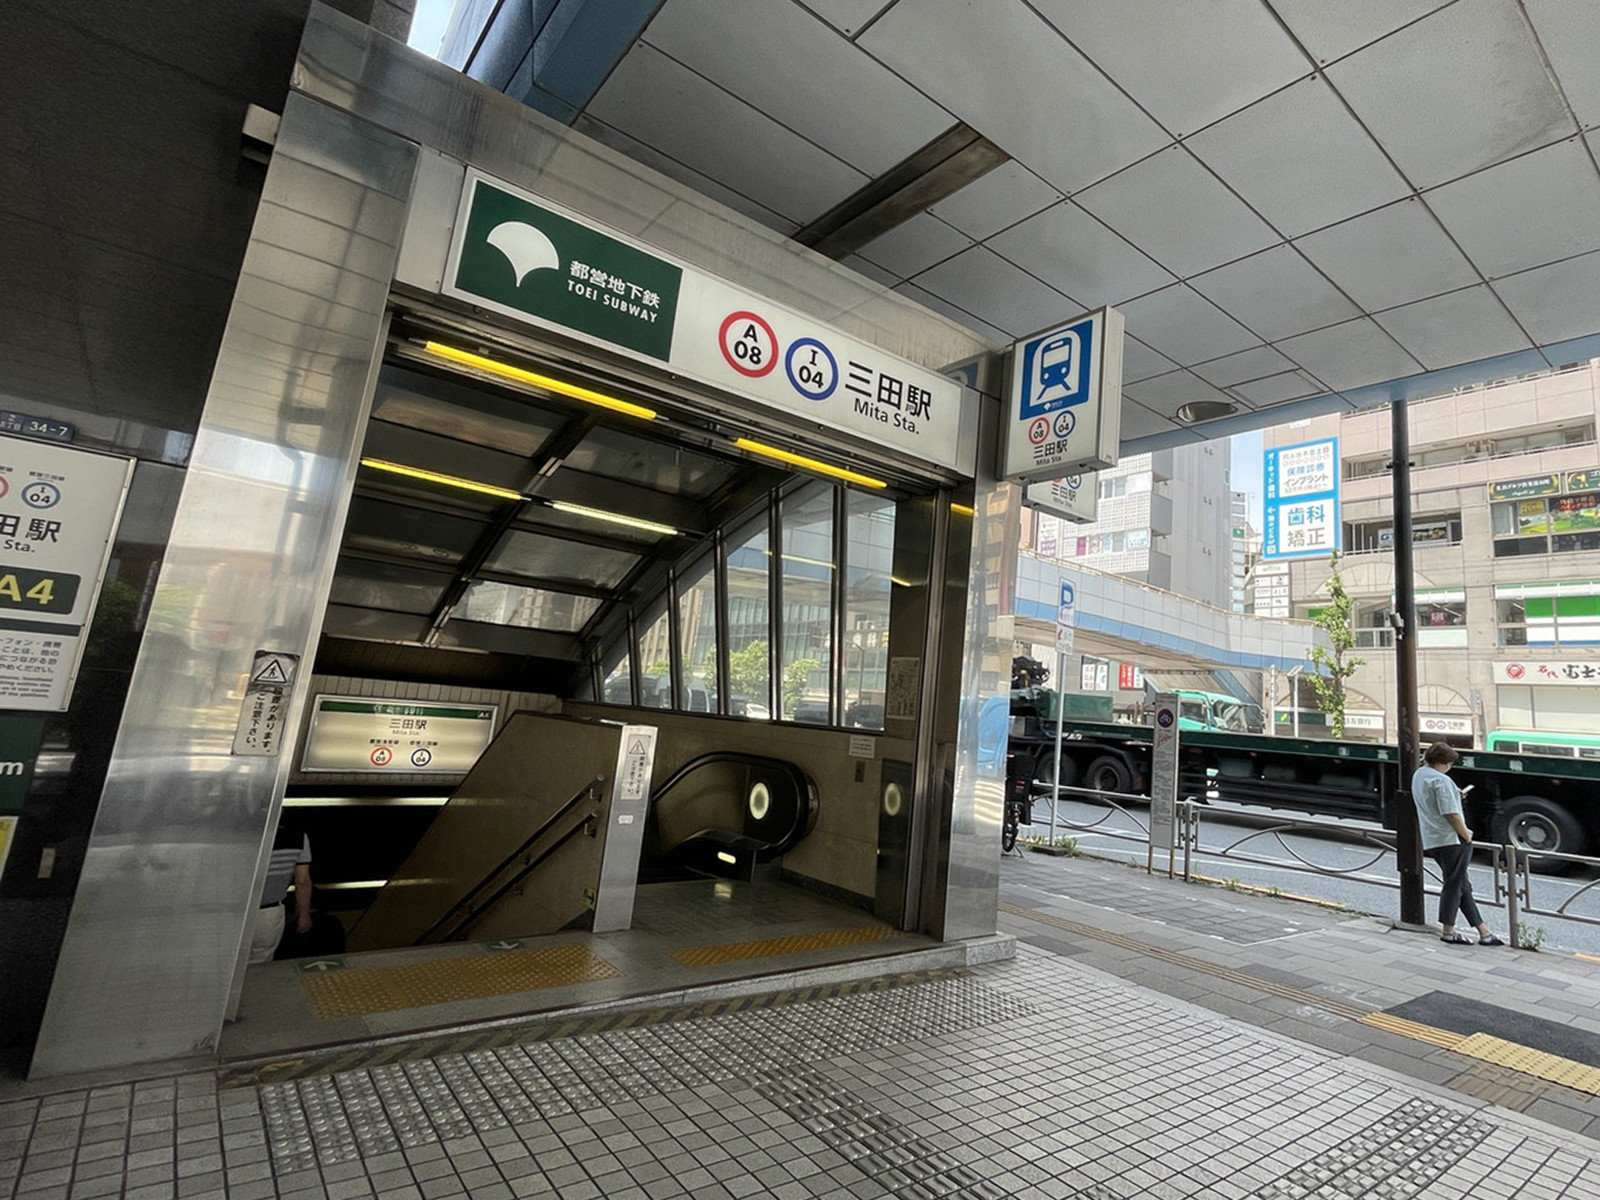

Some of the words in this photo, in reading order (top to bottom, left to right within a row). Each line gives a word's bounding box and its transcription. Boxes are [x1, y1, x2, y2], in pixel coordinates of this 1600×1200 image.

[570, 260, 660, 309] 都営地下鉄
[567, 280, 597, 300] TOEI
[603, 294, 657, 323] SUBWAY
[743, 323, 758, 343] A
[734, 340, 762, 365] 08
[809, 349, 819, 366] I
[798, 365, 824, 388] 04
[845, 361, 932, 421] 三田駅
[854, 398, 888, 423] Mita
[893, 412, 919, 435] Sta.
[29, 421, 68, 436] 34-7
[1058, 423, 1069, 433] 04
[1033, 439, 1068, 459] 三田駅
[1283, 473, 1329, 487] インプラント
[30, 493, 51, 503] 04
[1051, 483, 1077, 502] 三田駅
[1288, 504, 1325, 526] 歯科
[3, 539, 35, 553] Sta.
[1287, 527, 1326, 547] 矯正
[0, 574, 54, 605] A4
[1061, 581, 1074, 607] P
[1562, 664, 1600, 679] 富士
[389, 718, 428, 730] 三田駅
